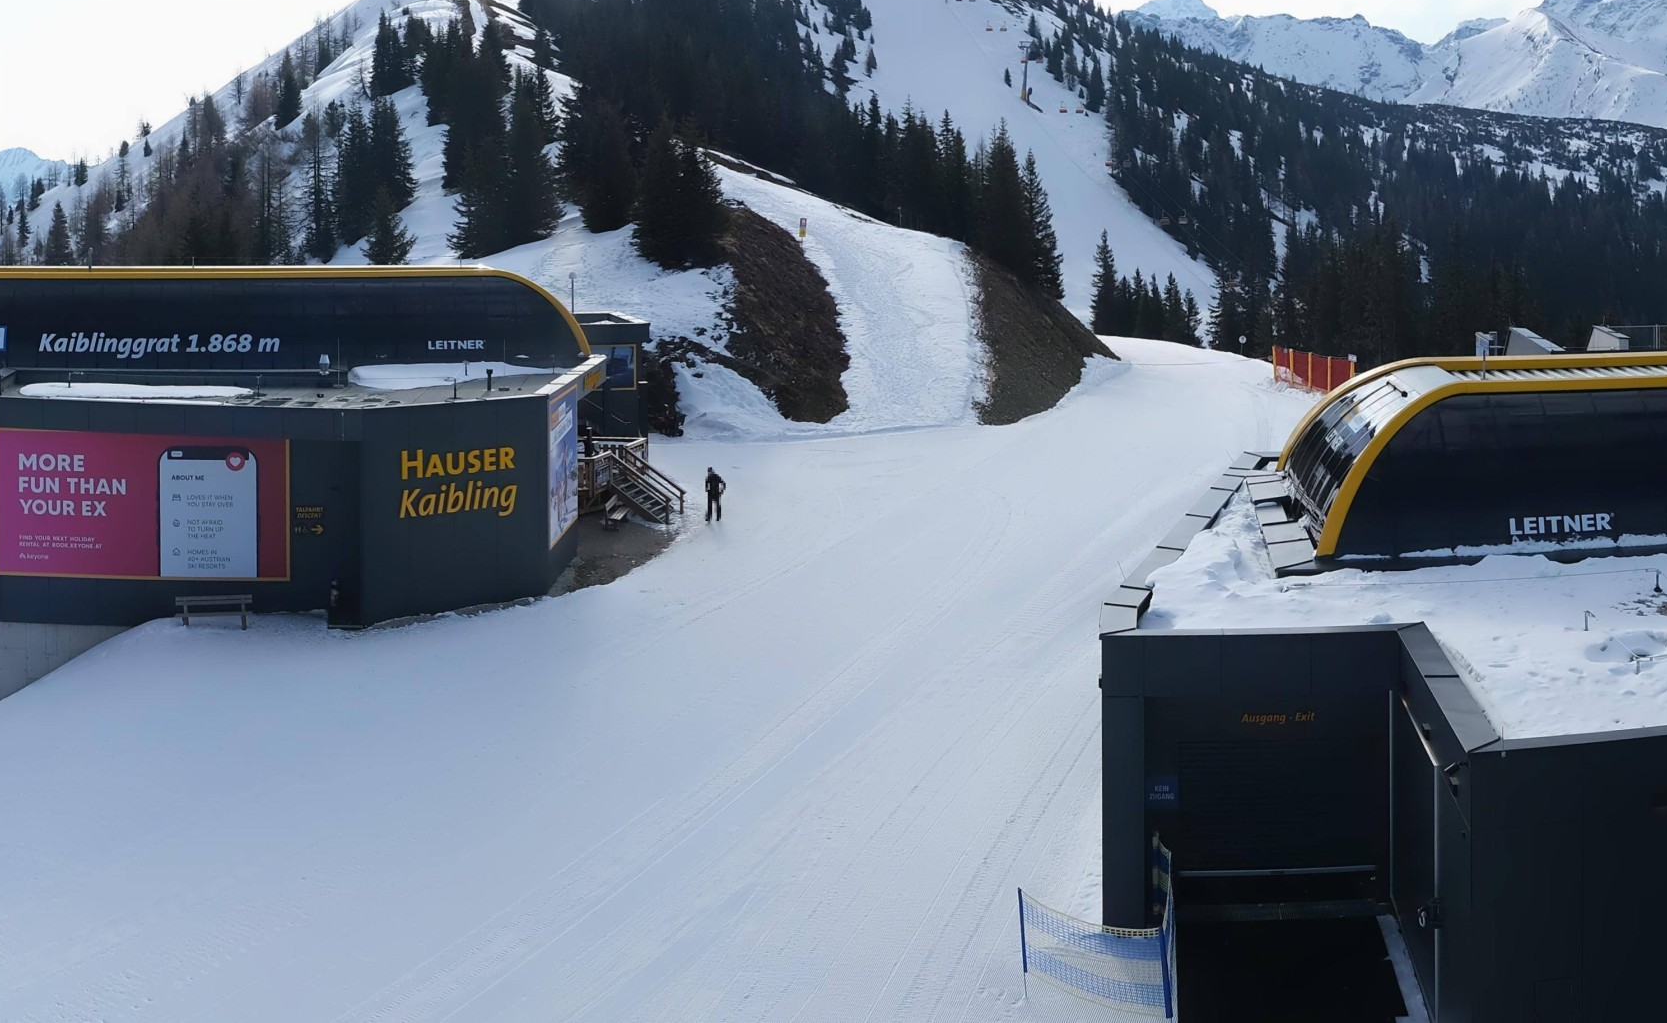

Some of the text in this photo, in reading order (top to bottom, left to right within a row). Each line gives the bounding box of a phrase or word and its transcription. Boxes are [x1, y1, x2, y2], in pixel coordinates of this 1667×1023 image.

[38, 332, 280, 359] Kaiblinggrat 1.868 m
[427, 340, 484, 350] LEITNER
[18, 453, 85, 472] MORE
[401, 447, 516, 480] HAUSER
[18, 476, 126, 495] FUN THAN
[19, 499, 107, 517] YOUR EX
[399, 480, 518, 519] Kaibling
[1509, 513, 1612, 535] LEITNER
[1241, 713, 1287, 725] Ausgang
[1295, 711, 1316, 722] Exit
